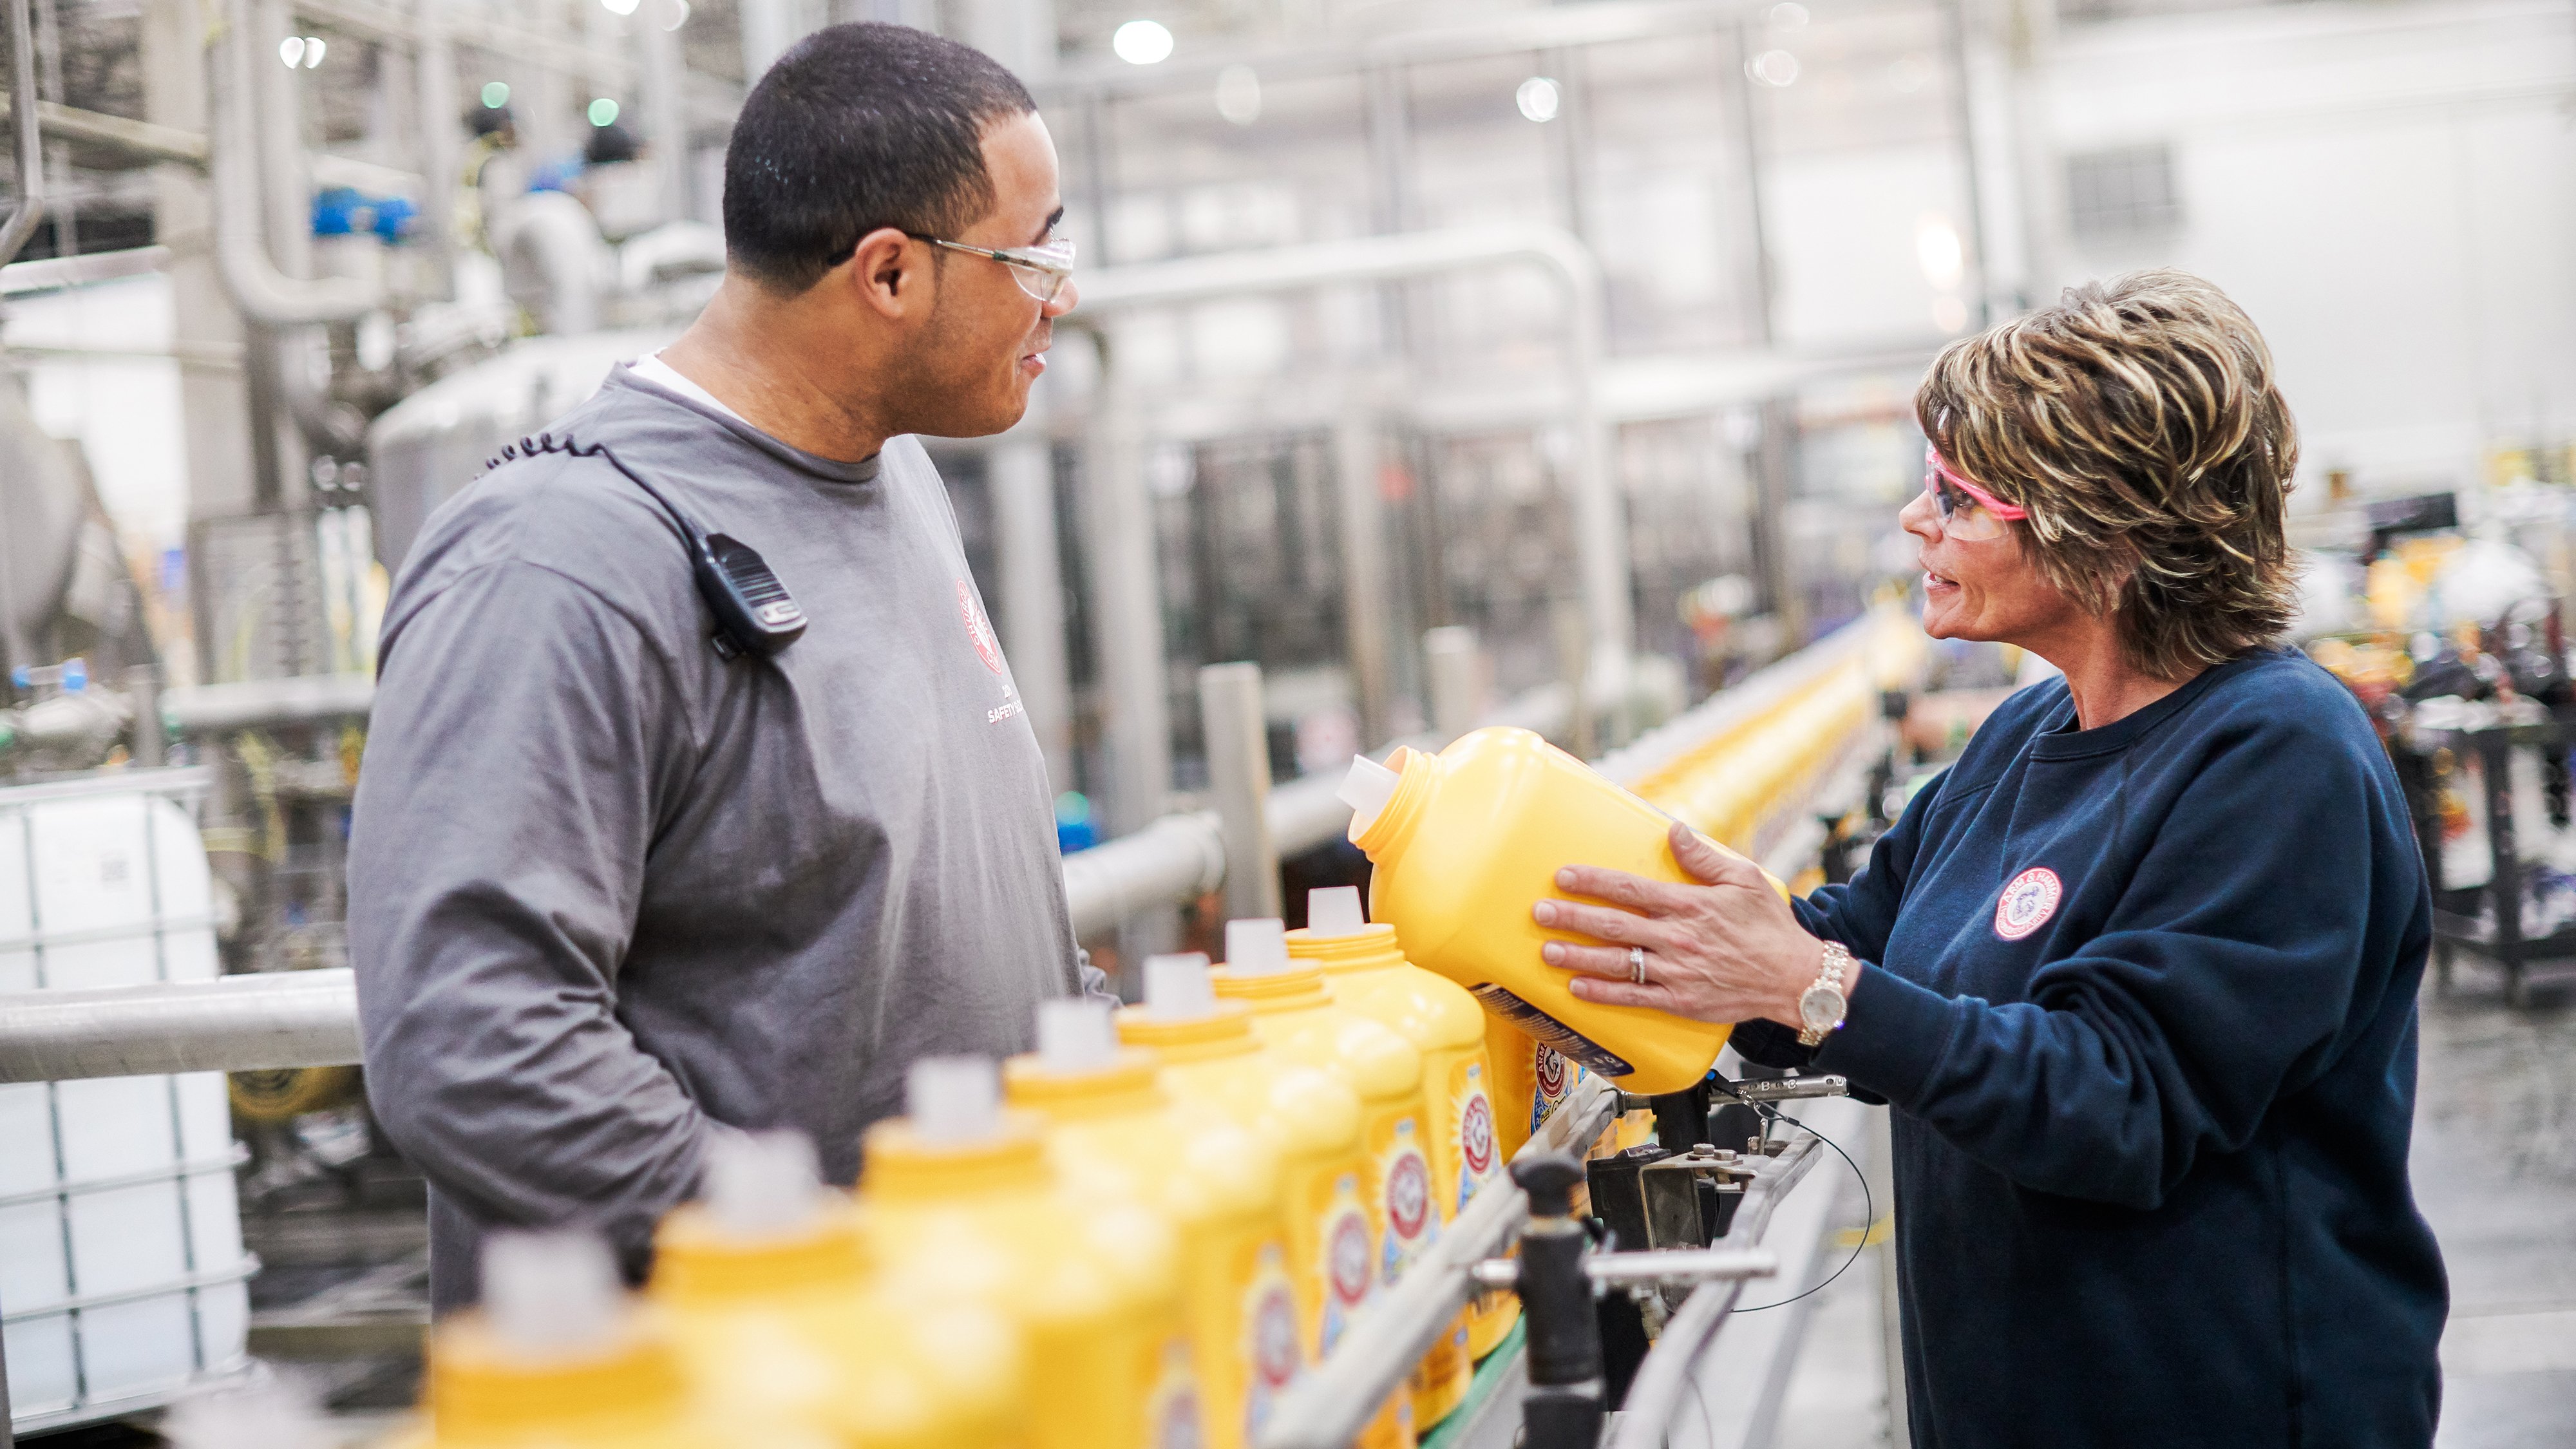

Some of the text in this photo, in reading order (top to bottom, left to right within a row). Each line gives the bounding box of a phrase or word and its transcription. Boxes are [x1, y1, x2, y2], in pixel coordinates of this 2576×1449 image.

[988, 703, 1016, 723] SAFETY
[2003, 878, 2025, 902] ARM
[2026, 873, 2035, 882] &
[1761, 1081, 1770, 1091] B
[1788, 1079, 1797, 1090] C
